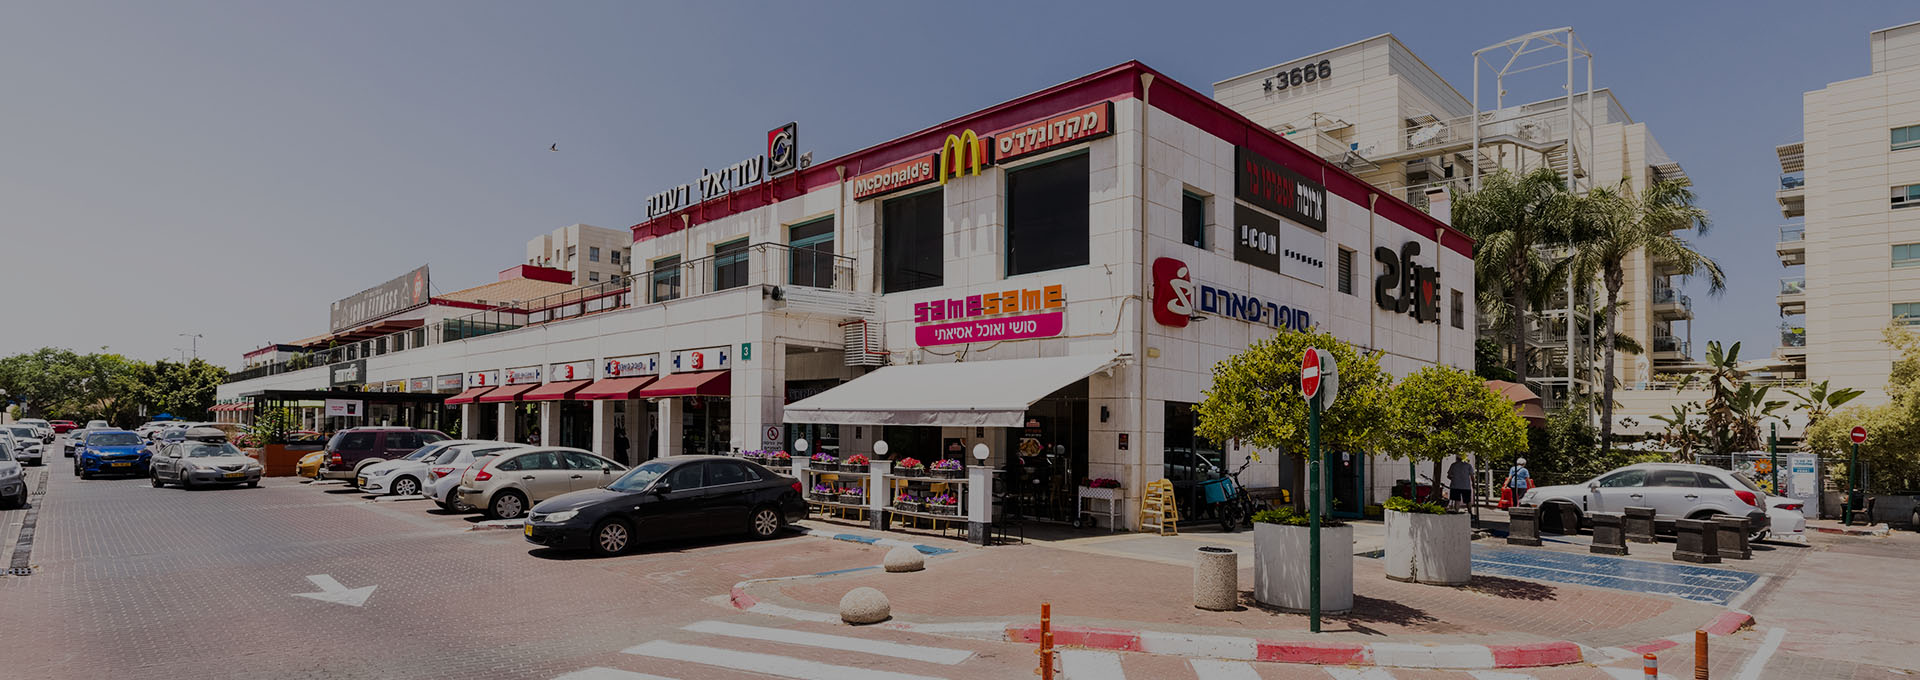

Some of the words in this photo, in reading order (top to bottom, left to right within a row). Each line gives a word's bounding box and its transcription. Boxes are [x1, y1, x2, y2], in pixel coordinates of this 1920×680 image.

[696, 154, 763, 199] עזריאלי
[855, 162, 930, 196] McDonald's
[1262, 166, 1294, 208] אספרסו
[645, 183, 690, 217] רעננה
[1296, 180, 1322, 221] ארומה
[1201, 285, 1310, 334] סופר-פארם
[934, 325, 973, 341] אסיאתי
[976, 322, 1005, 337] ואוכל
[1009, 320, 1037, 334] סושי
[743, 346, 749, 356] 3
